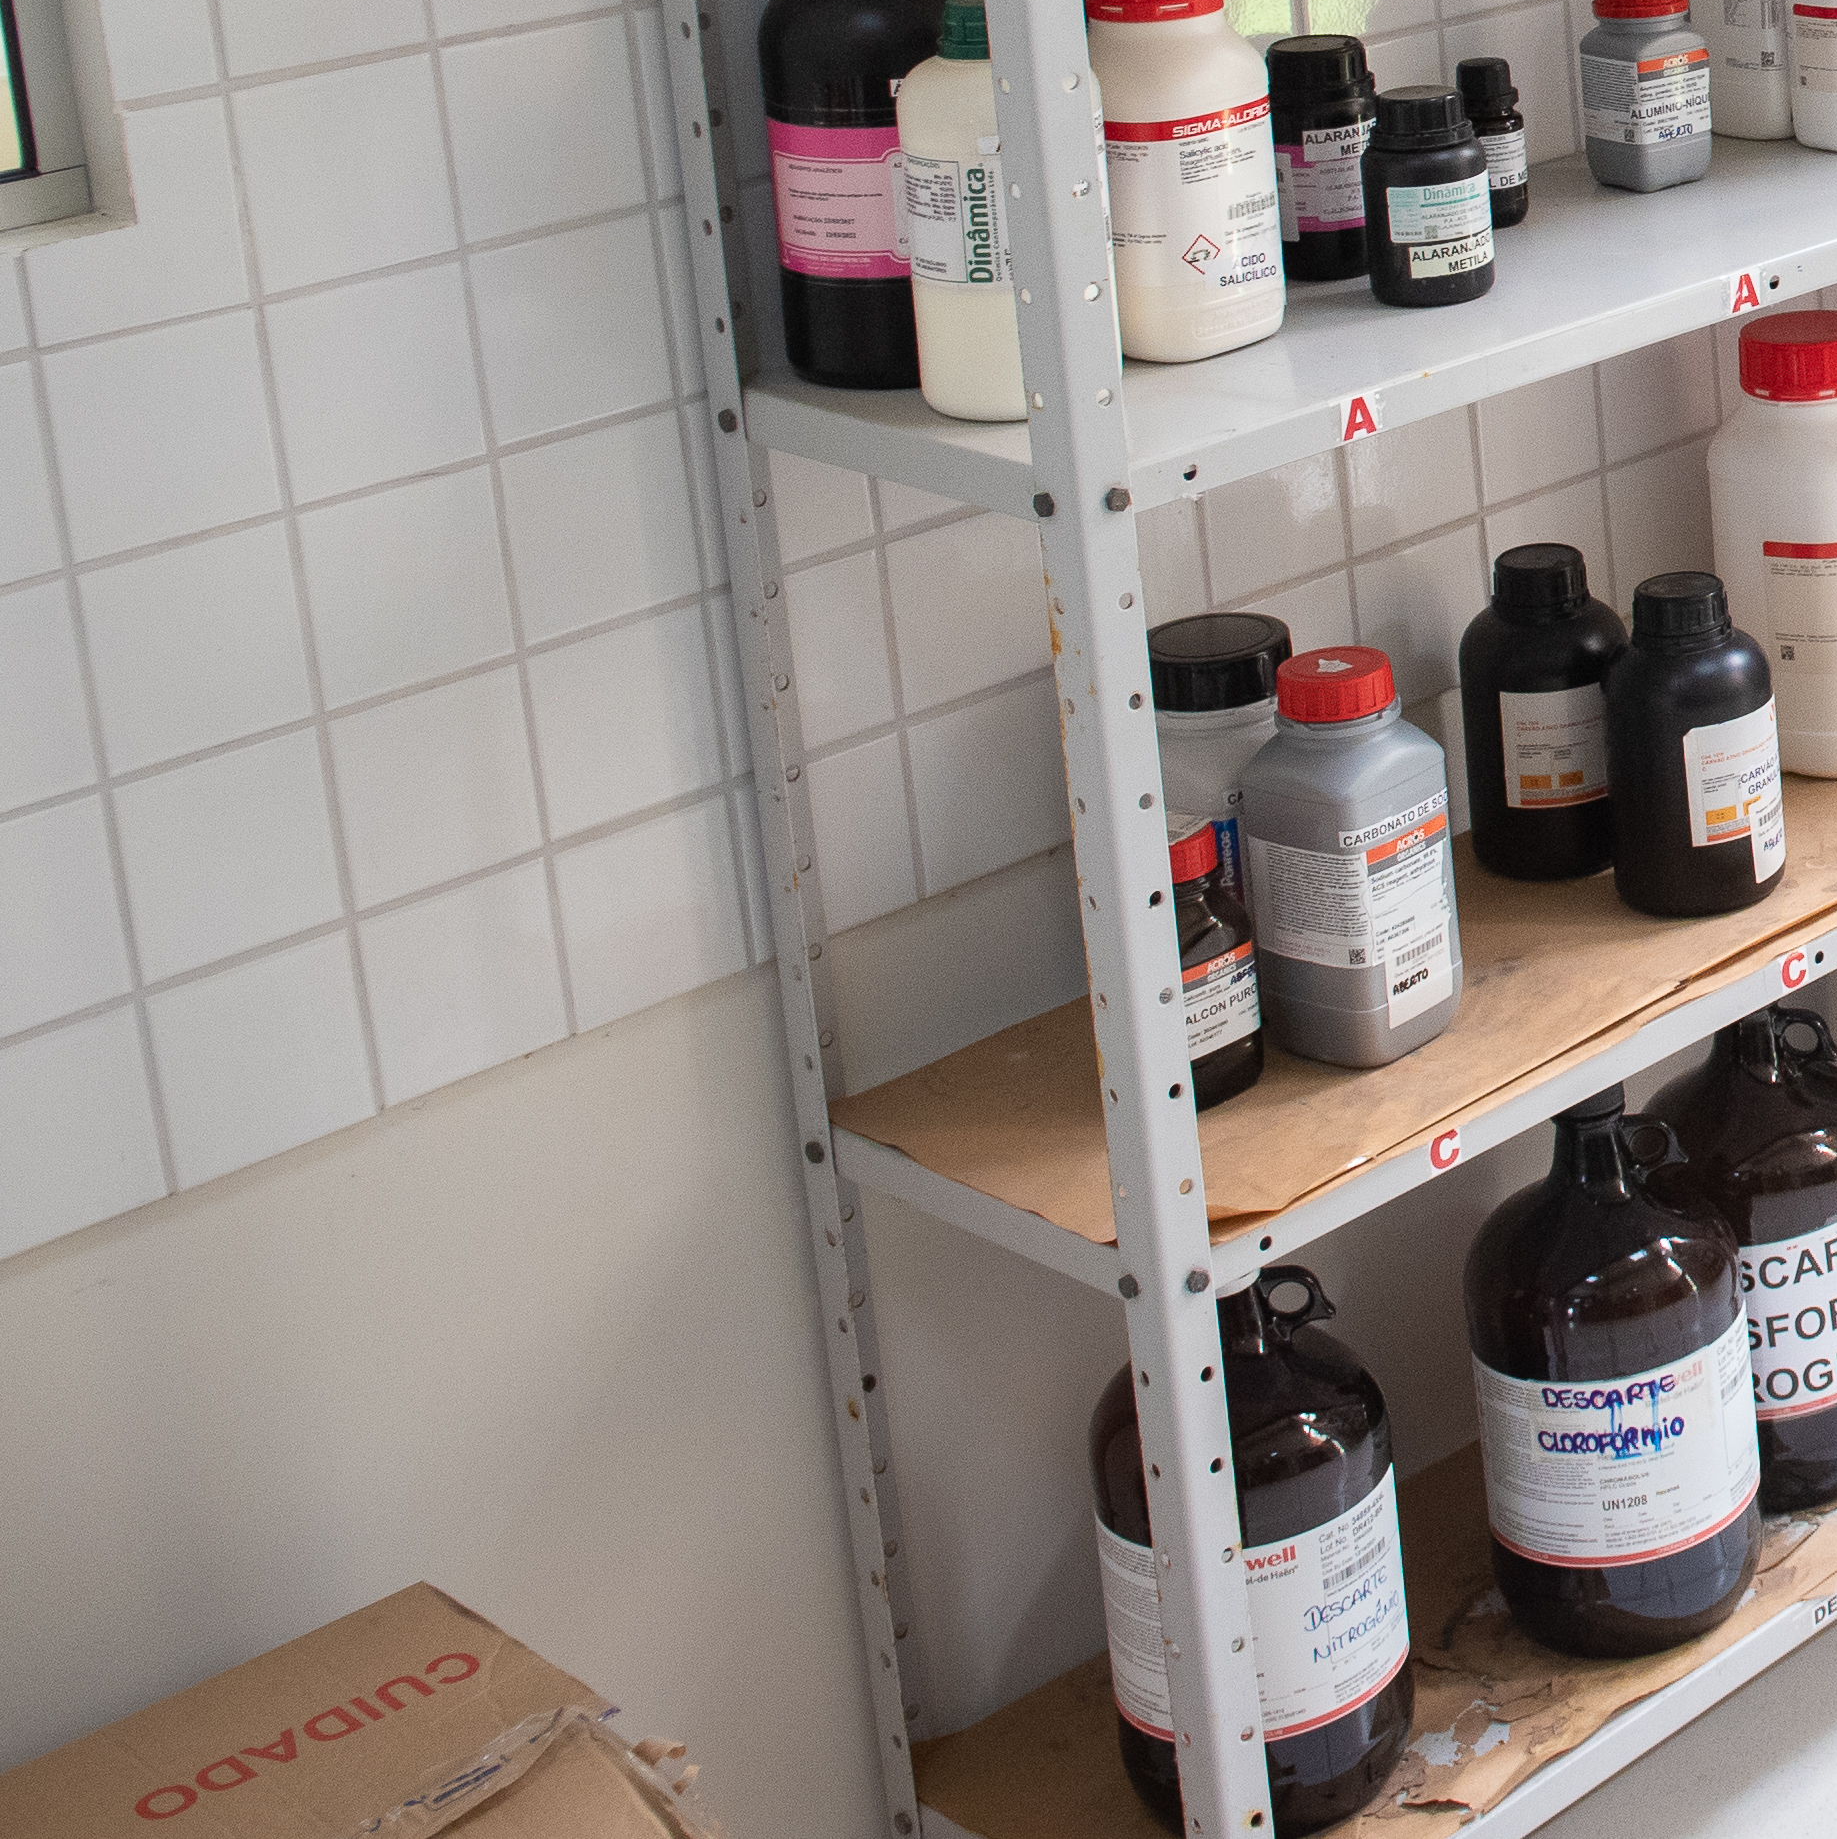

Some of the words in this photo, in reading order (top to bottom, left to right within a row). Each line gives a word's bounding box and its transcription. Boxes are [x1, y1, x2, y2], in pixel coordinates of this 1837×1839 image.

[1423, 181, 1477, 202] Dinâmica
[967, 167, 994, 285] Dinâmica
[1219, 264, 1277, 288] SALICÍLICO
[1232, 251, 1267, 269] ÁCIDO
[1447, 253, 1489, 273] METILA
[1732, 274, 1760, 313] A
[1344, 398, 1377, 441] A
[1343, 811, 1417, 848] CARBONATO
[1417, 803, 1432, 819] DE
[1395, 827, 1425, 852] ACROS
[1206, 952, 1236, 973] ACROS
[1781, 952, 1806, 988] C
[1228, 981, 1258, 1008] PURO
[1391, 968, 1430, 997] ABERTO
[1430, 1129, 1460, 1170] C
[1541, 1373, 1676, 1410] DESCARTE
[1601, 1494, 1649, 1512] UN1208
[1303, 1564, 1388, 1634] DESCARTE
[134, 1650, 481, 1823] CUIDADO
